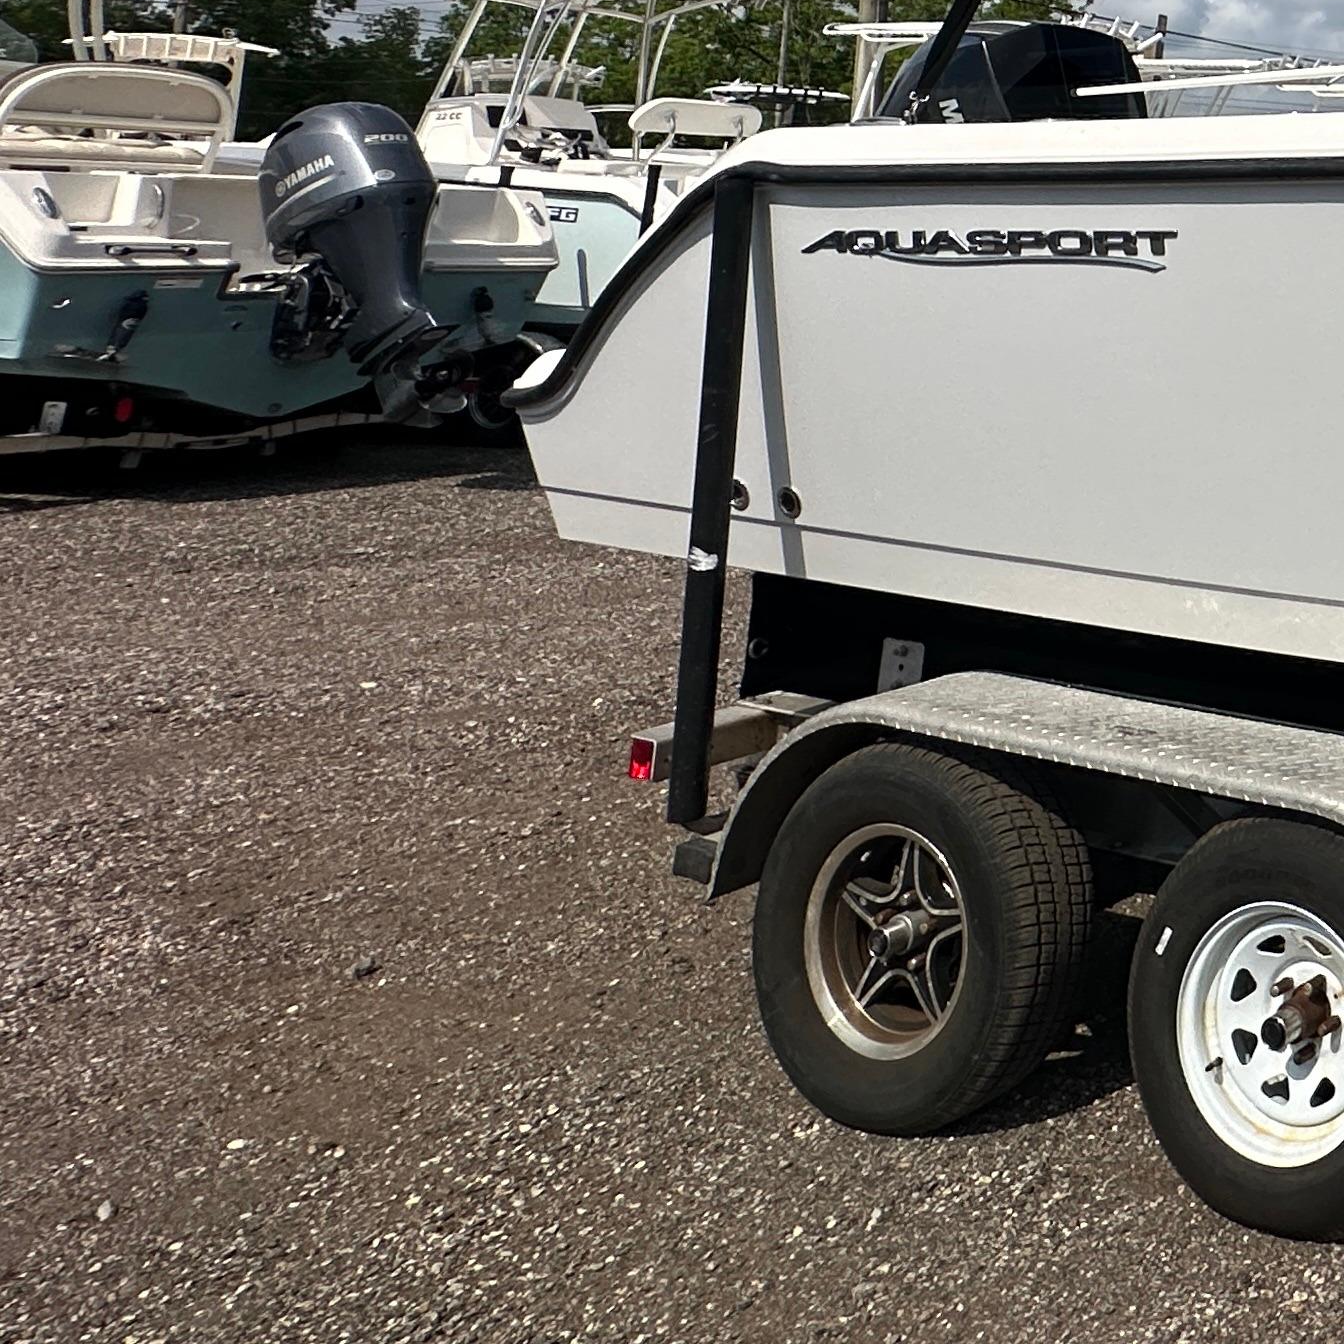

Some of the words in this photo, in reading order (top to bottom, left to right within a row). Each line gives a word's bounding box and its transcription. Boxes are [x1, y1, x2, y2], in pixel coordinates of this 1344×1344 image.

[449, 112, 462, 120] CC
[364, 133, 408, 143] 200
[284, 154, 335, 190] YAMAHA
[801, 230, 1178, 256] AQUASPORT
